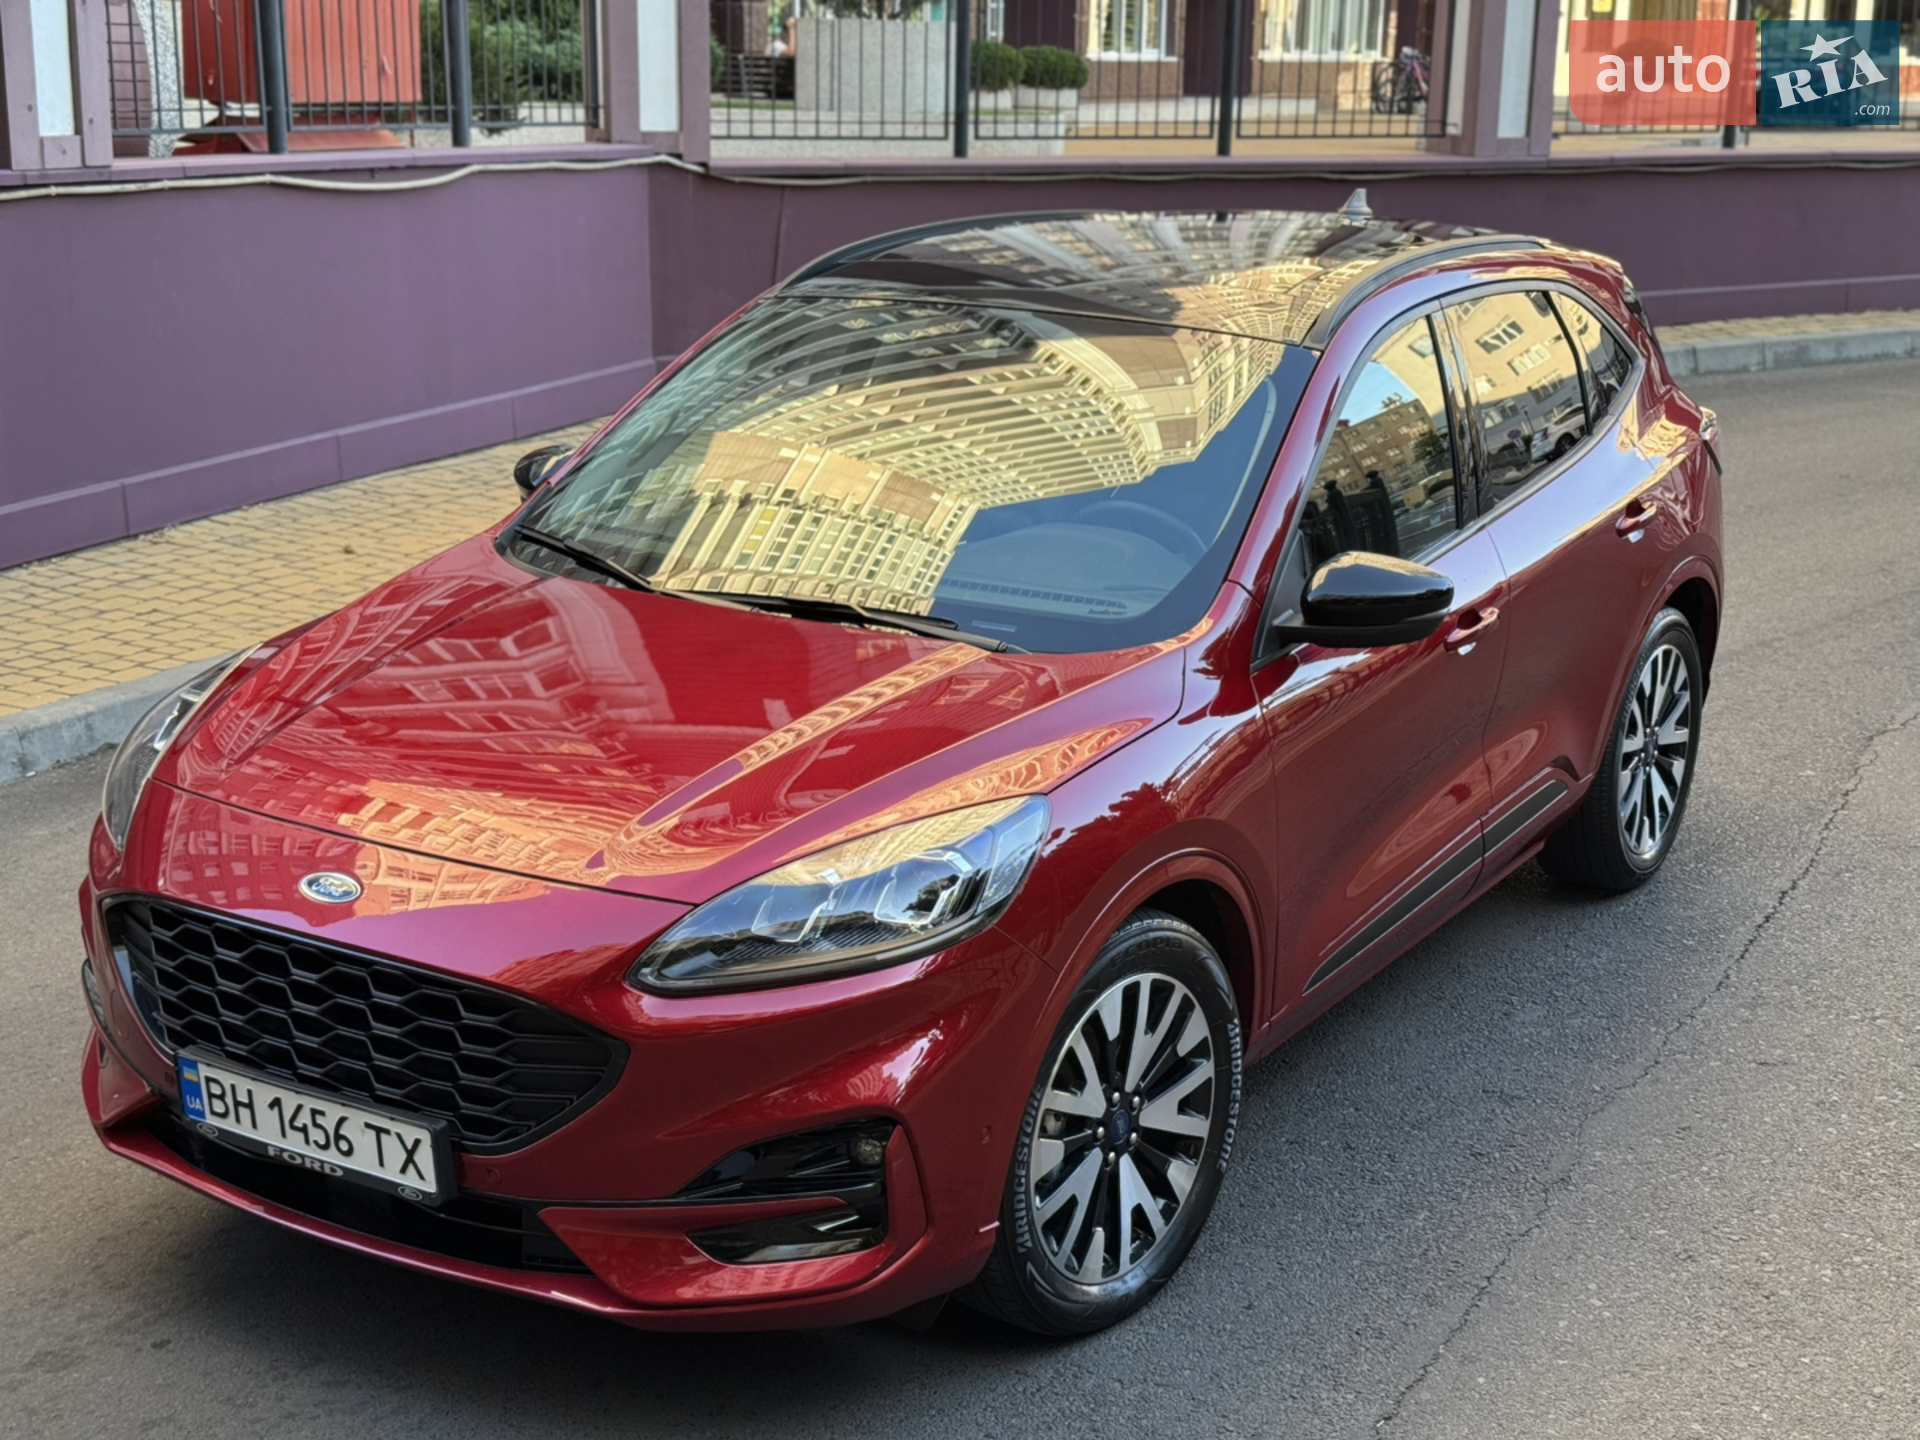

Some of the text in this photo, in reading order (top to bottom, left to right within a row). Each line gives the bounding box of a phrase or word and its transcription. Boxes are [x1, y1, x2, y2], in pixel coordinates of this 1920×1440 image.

[311, 876, 348, 897] Ford
[186, 1094, 204, 1111] UA
[204, 1074, 426, 1181] BH 1456 TX
[267, 1145, 344, 1176] FORD
